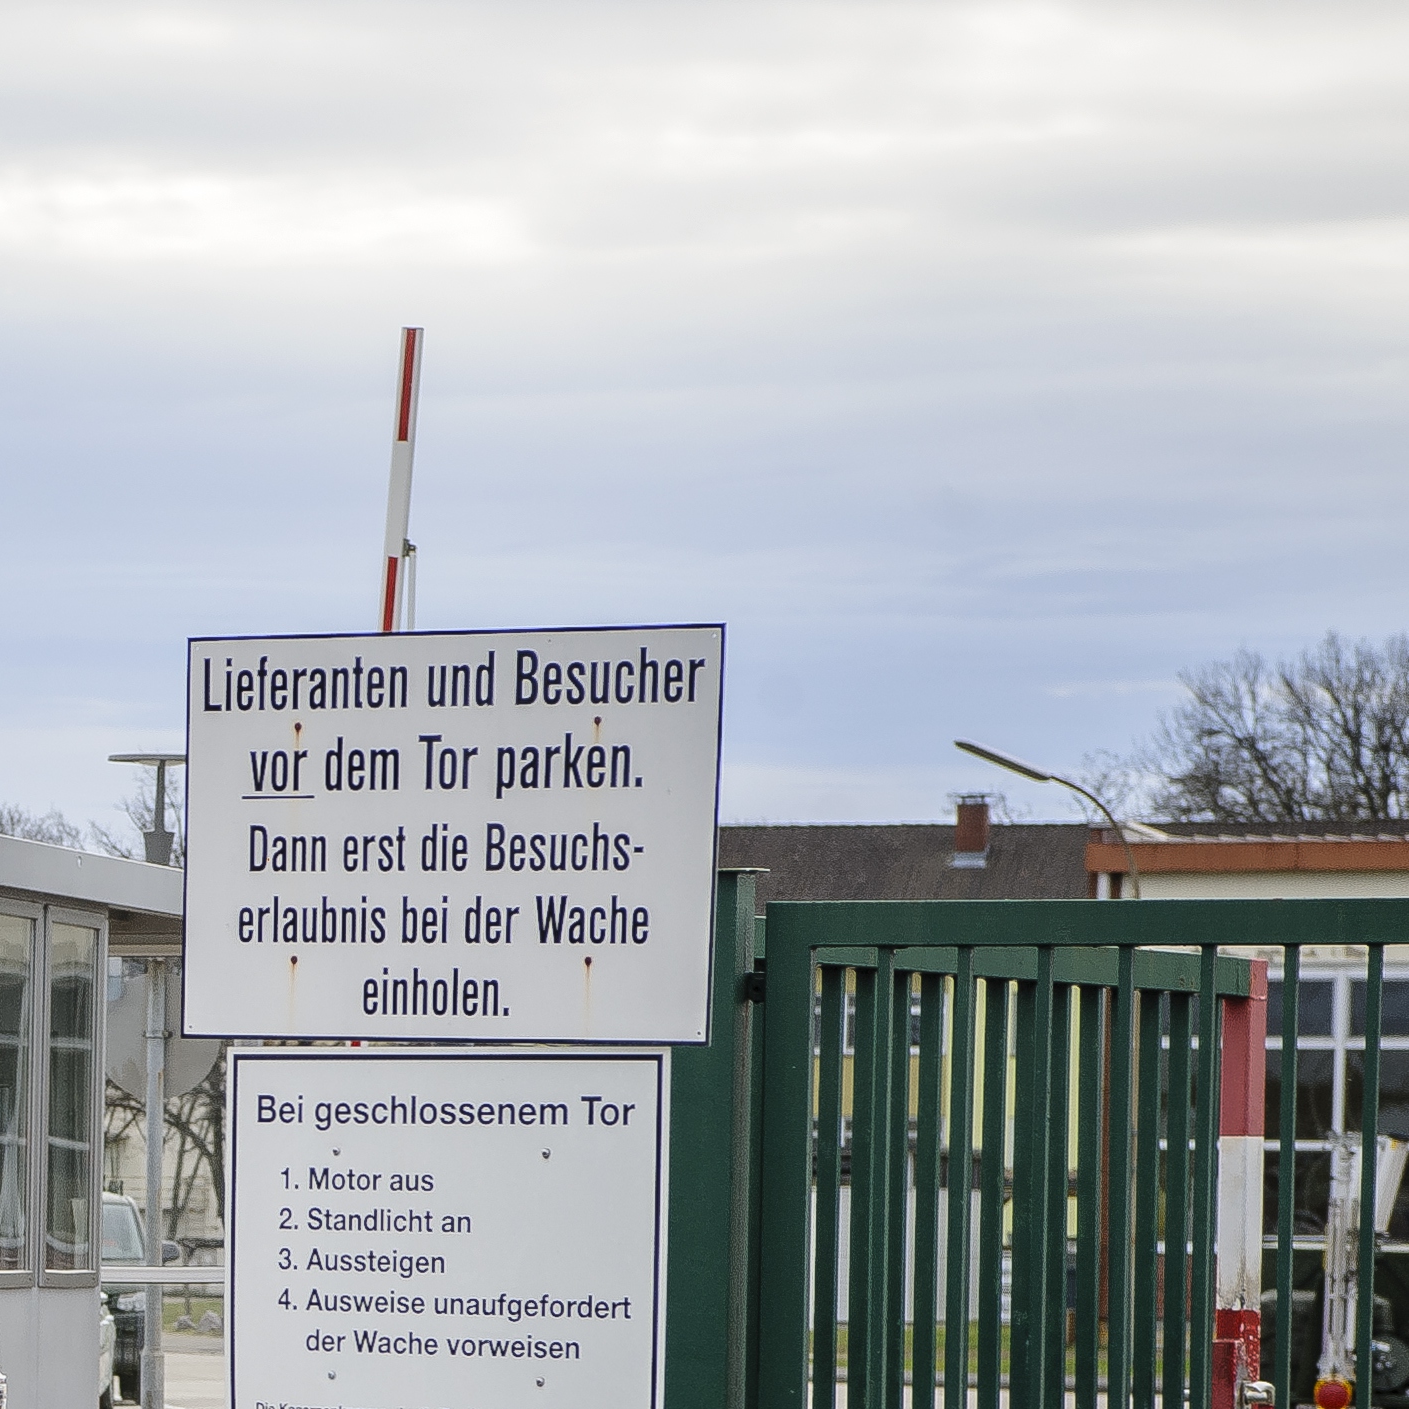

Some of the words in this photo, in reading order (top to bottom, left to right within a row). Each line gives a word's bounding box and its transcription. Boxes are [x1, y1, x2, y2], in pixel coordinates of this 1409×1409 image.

[203, 655, 408, 712] Lieferanten
[427, 650, 496, 708] und
[515, 646, 706, 706] Besucher
[249, 749, 308, 792] vor
[325, 736, 400, 791] dem
[418, 734, 479, 790] Tor
[495, 732, 643, 800] parken.
[249, 824, 327, 872] Dann
[343, 826, 406, 873] erst
[421, 823, 468, 872] die
[485, 821, 644, 872] Besuchs-
[238, 895, 386, 944] erlaubnis
[401, 895, 448, 944] bei
[464, 895, 520, 945] der
[535, 895, 649, 945] Wache
[363, 967, 510, 1017] einholen.
[257, 1094, 303, 1124] Bei
[314, 1095, 568, 1131] geschlossenem
[580, 1095, 636, 1126] Tor
[280, 1167, 299, 1190] 1.
[308, 1167, 382, 1191] Motor
[389, 1174, 434, 1192] aus
[278, 1207, 299, 1230] 2.
[307, 1207, 434, 1233] Standlicht
[441, 1215, 471, 1234] an
[278, 1247, 298, 1270] 3.
[306, 1247, 445, 1279] Aussteigen
[277, 1287, 298, 1311] 4.
[305, 1288, 426, 1315] Ausweise
[434, 1293, 632, 1323] unaufgefordert
[306, 1328, 346, 1352] der
[353, 1330, 439, 1356] Wache
[446, 1334, 580, 1360] vorweisen
